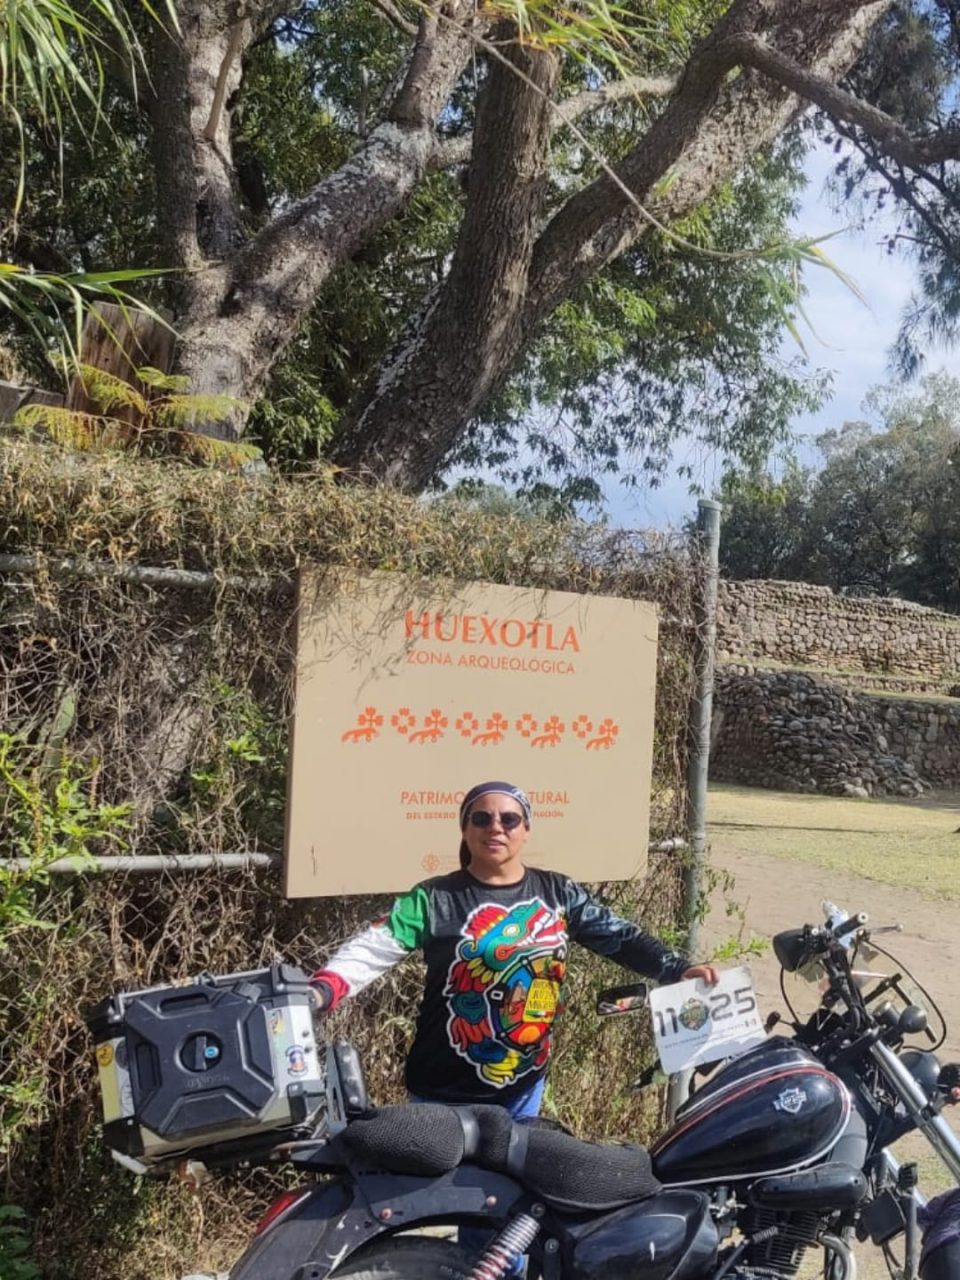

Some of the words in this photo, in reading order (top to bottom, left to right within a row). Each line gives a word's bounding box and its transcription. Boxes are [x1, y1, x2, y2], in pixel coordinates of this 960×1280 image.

[404, 609, 581, 653] HUEXOTLA
[406, 650, 453, 665] ZONA
[457, 654, 575, 675] ARQUEOLOGICA
[400, 790, 465, 805] PATRIMO
[527, 790, 570, 805] TURAL
[709, 986, 756, 1022] 25
